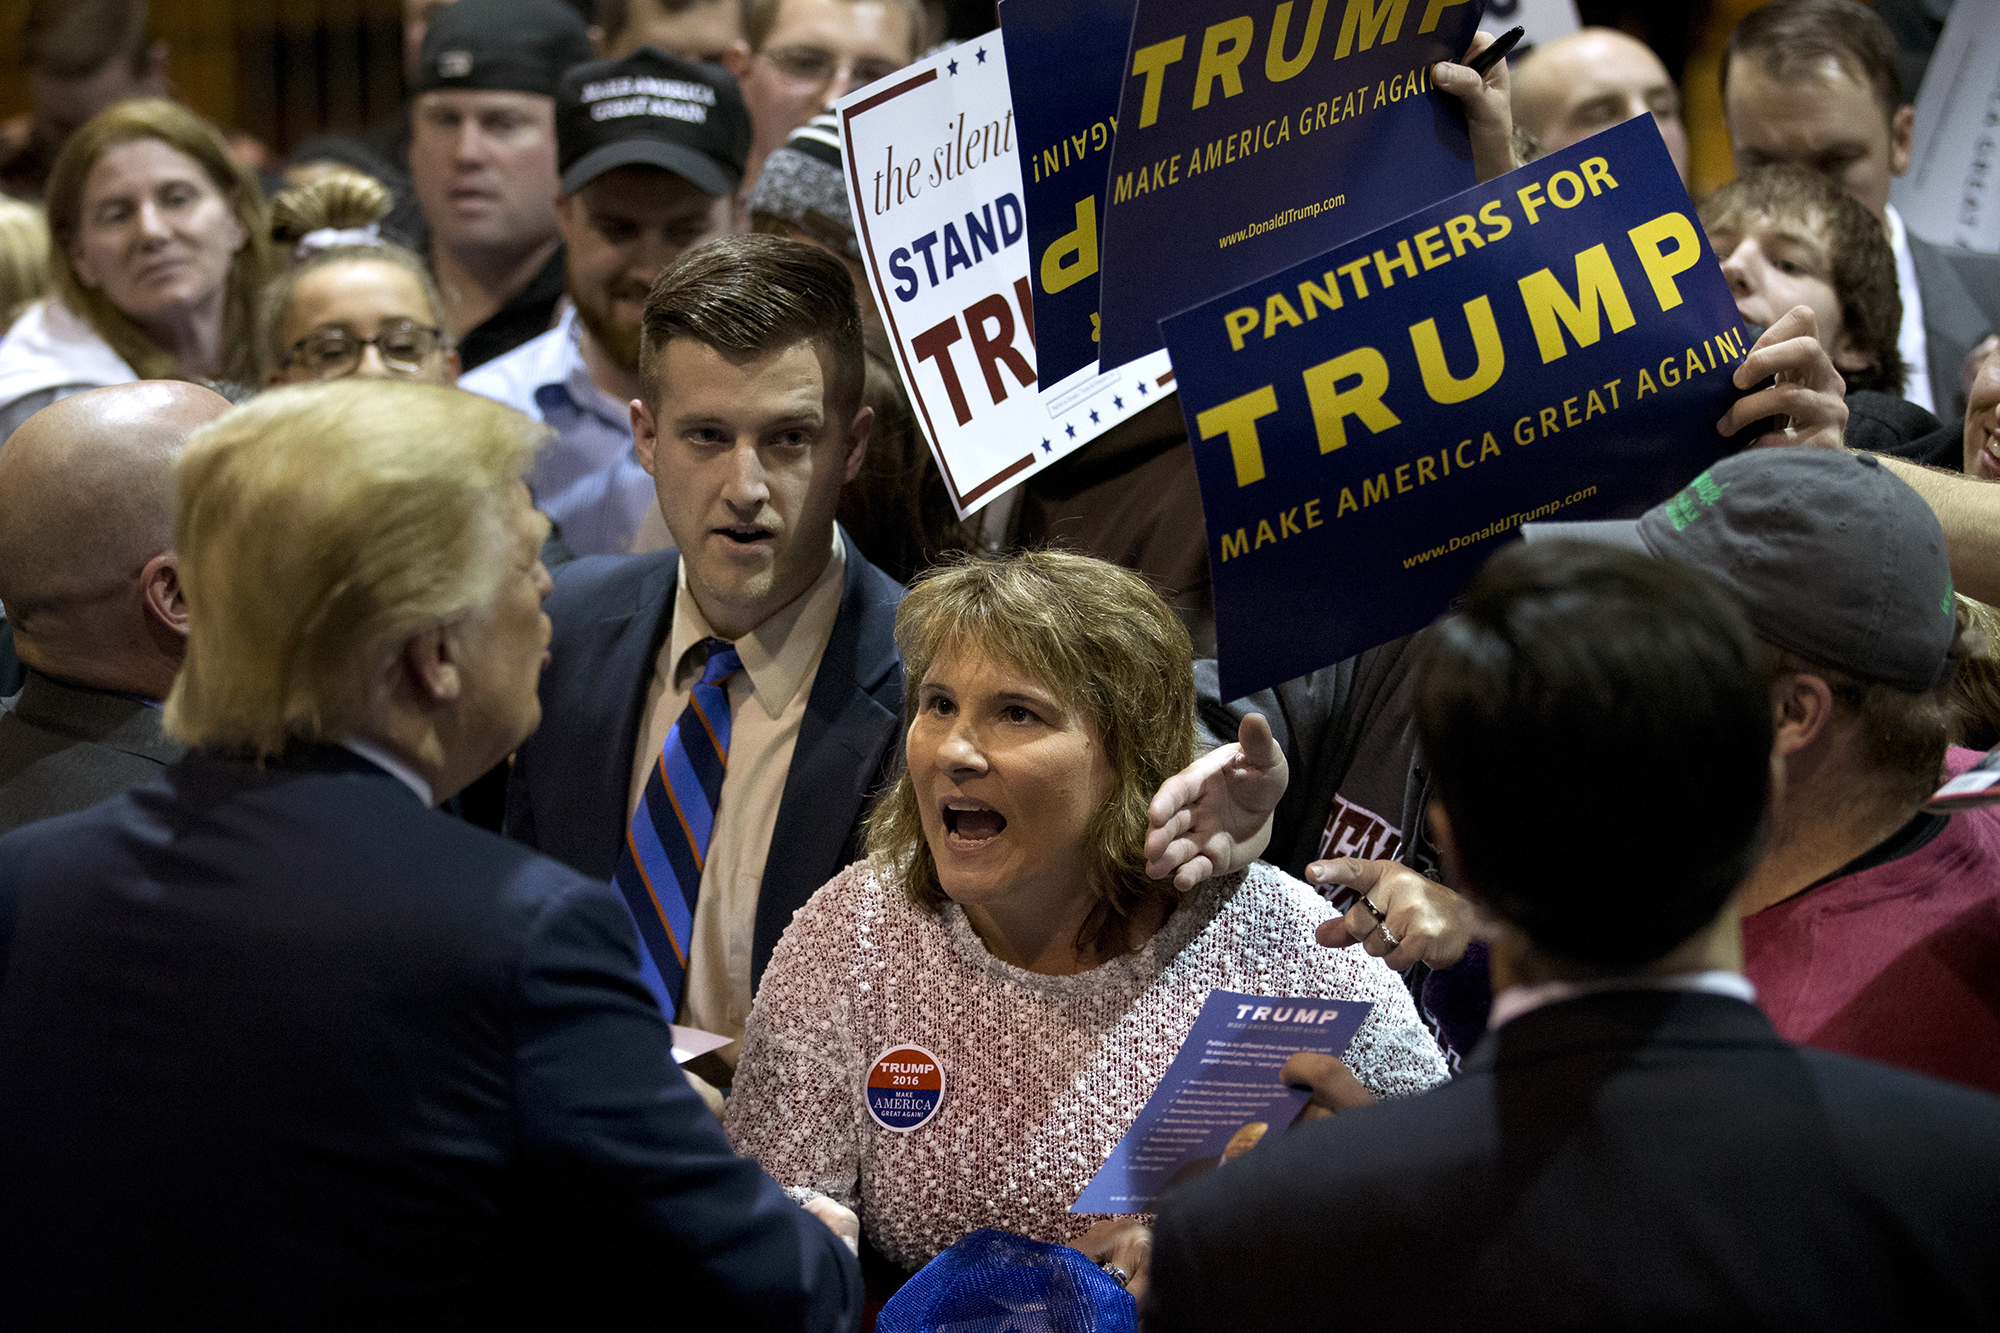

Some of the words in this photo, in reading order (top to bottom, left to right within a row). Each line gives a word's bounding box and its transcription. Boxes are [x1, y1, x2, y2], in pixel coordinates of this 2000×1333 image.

[873, 145, 922, 216] the
[928, 109, 1014, 188] silent
[1113, 154, 1181, 205] MAKE
[1187, 115, 1290, 178] AMERICA
[1299, 86, 1369, 136] GREAT
[888, 192, 1023, 303] STAND
[1219, 192, 1345, 249] www.DonaldJTrump.com
[1223, 199, 1513, 352] PANTHERS
[1516, 156, 1619, 225] FOR
[1195, 211, 1701, 488] TRUMP
[1220, 498, 1324, 563] MAKE
[1336, 431, 1501, 518] AMERICA
[1513, 378, 1621, 446] GREAT
[1636, 326, 1747, 400] AGAIN!
[1402, 485, 1597, 569] www.DonaldJTrump.com
[1236, 1003, 1339, 1025] TRUMP
[874, 1098, 931, 1110] AMERICA
[880, 1062, 935, 1074] TRUMP
[892, 1075, 919, 1085] 2016
